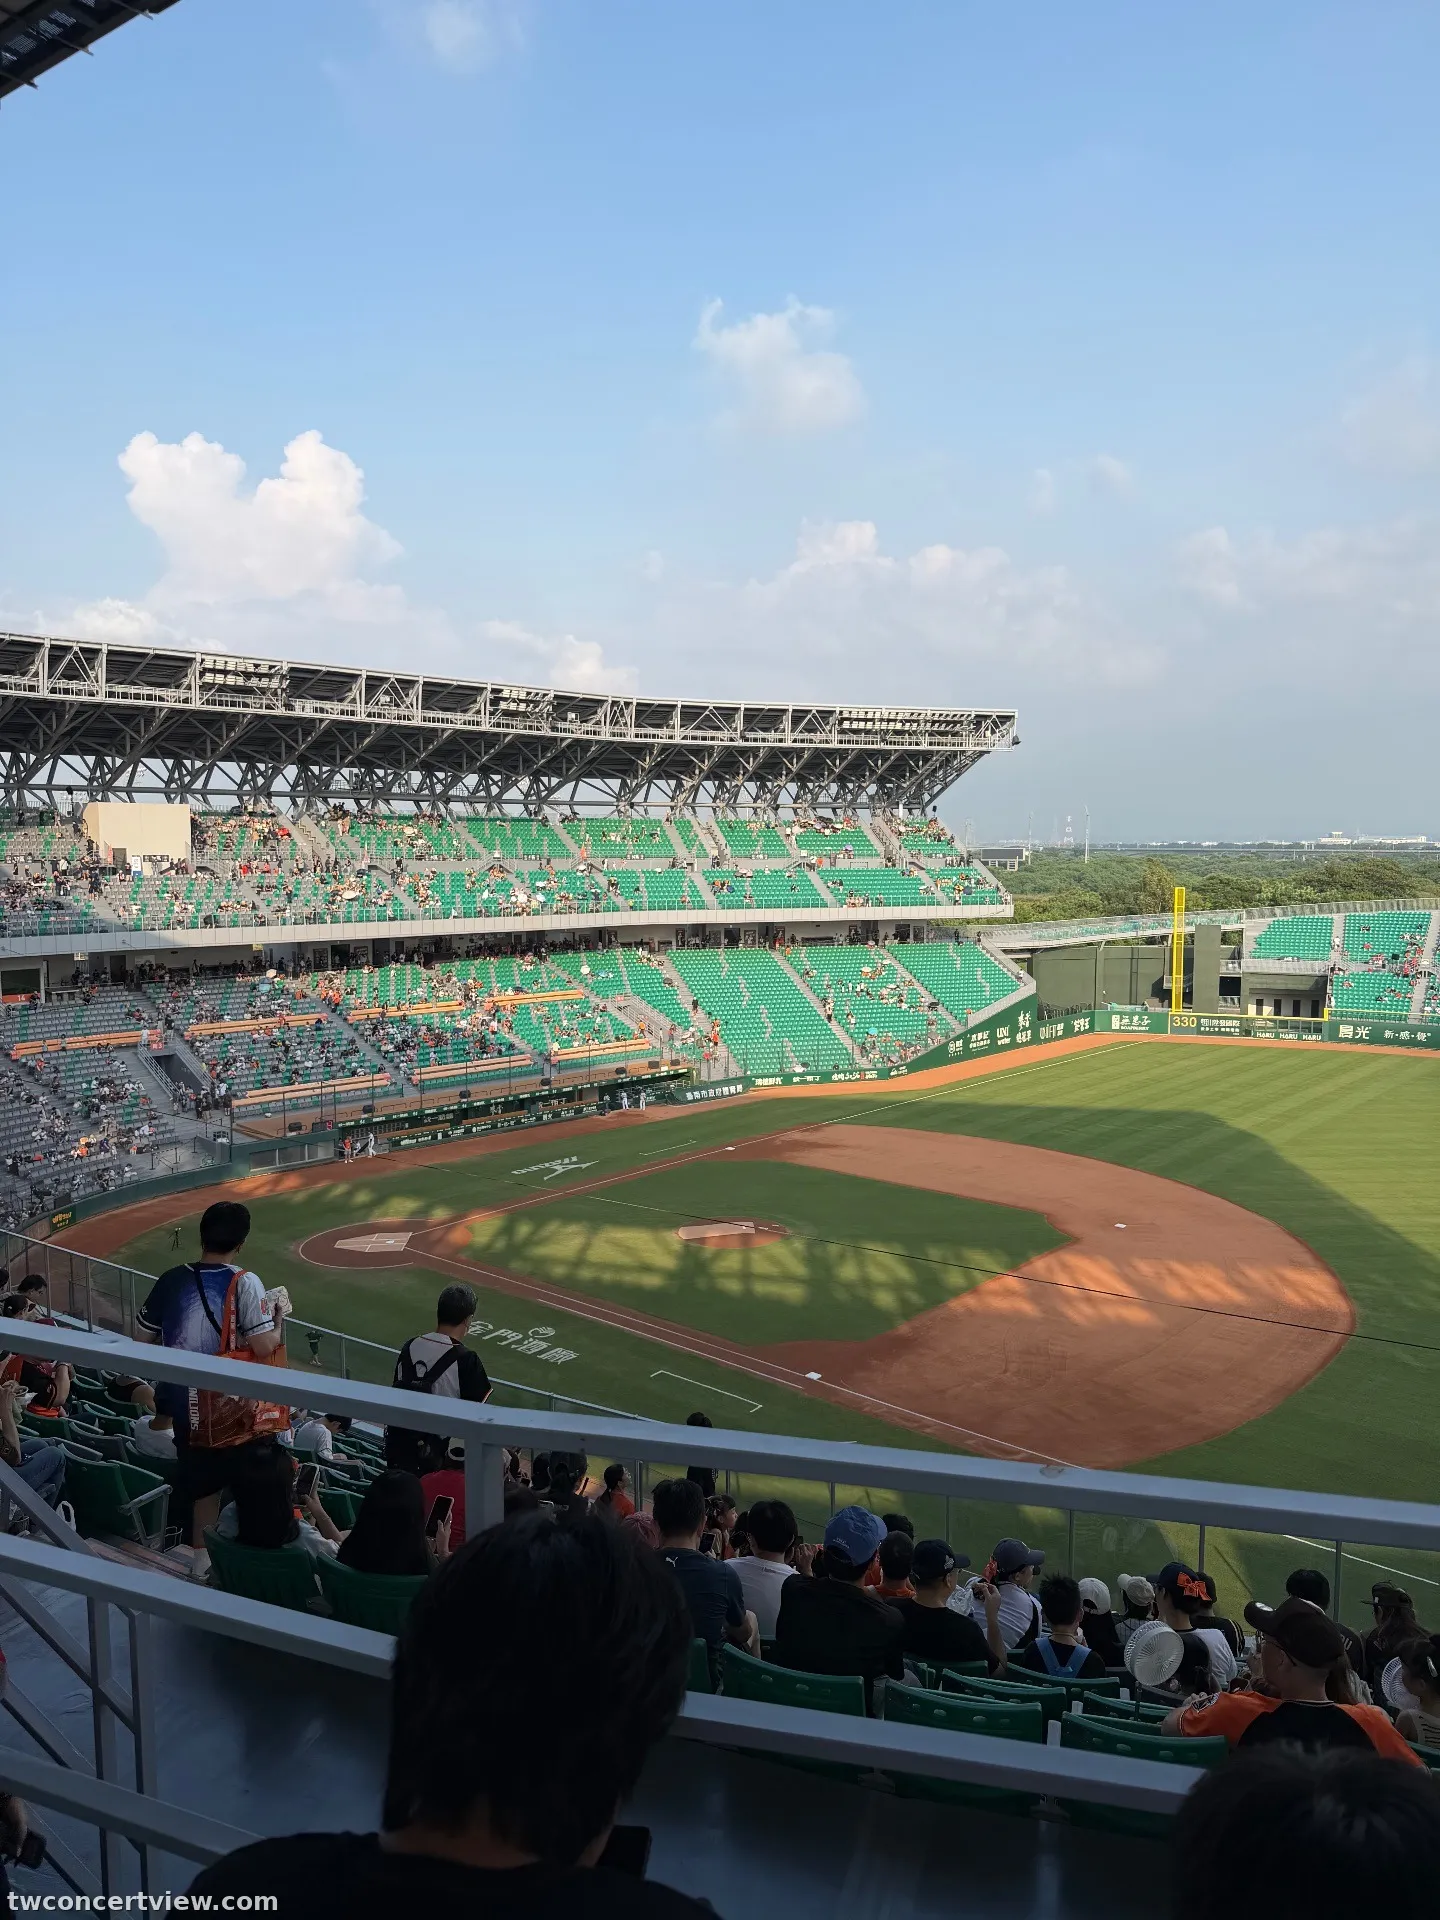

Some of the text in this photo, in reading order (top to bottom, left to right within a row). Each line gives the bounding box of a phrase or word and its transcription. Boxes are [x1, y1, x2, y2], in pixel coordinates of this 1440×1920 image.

[17, 994, 26, 1002] 14
[1172, 1016, 1198, 1028] 330
[1256, 1031, 1275, 1039] HARU
[1338, 1024, 1370, 1040] 晨光
